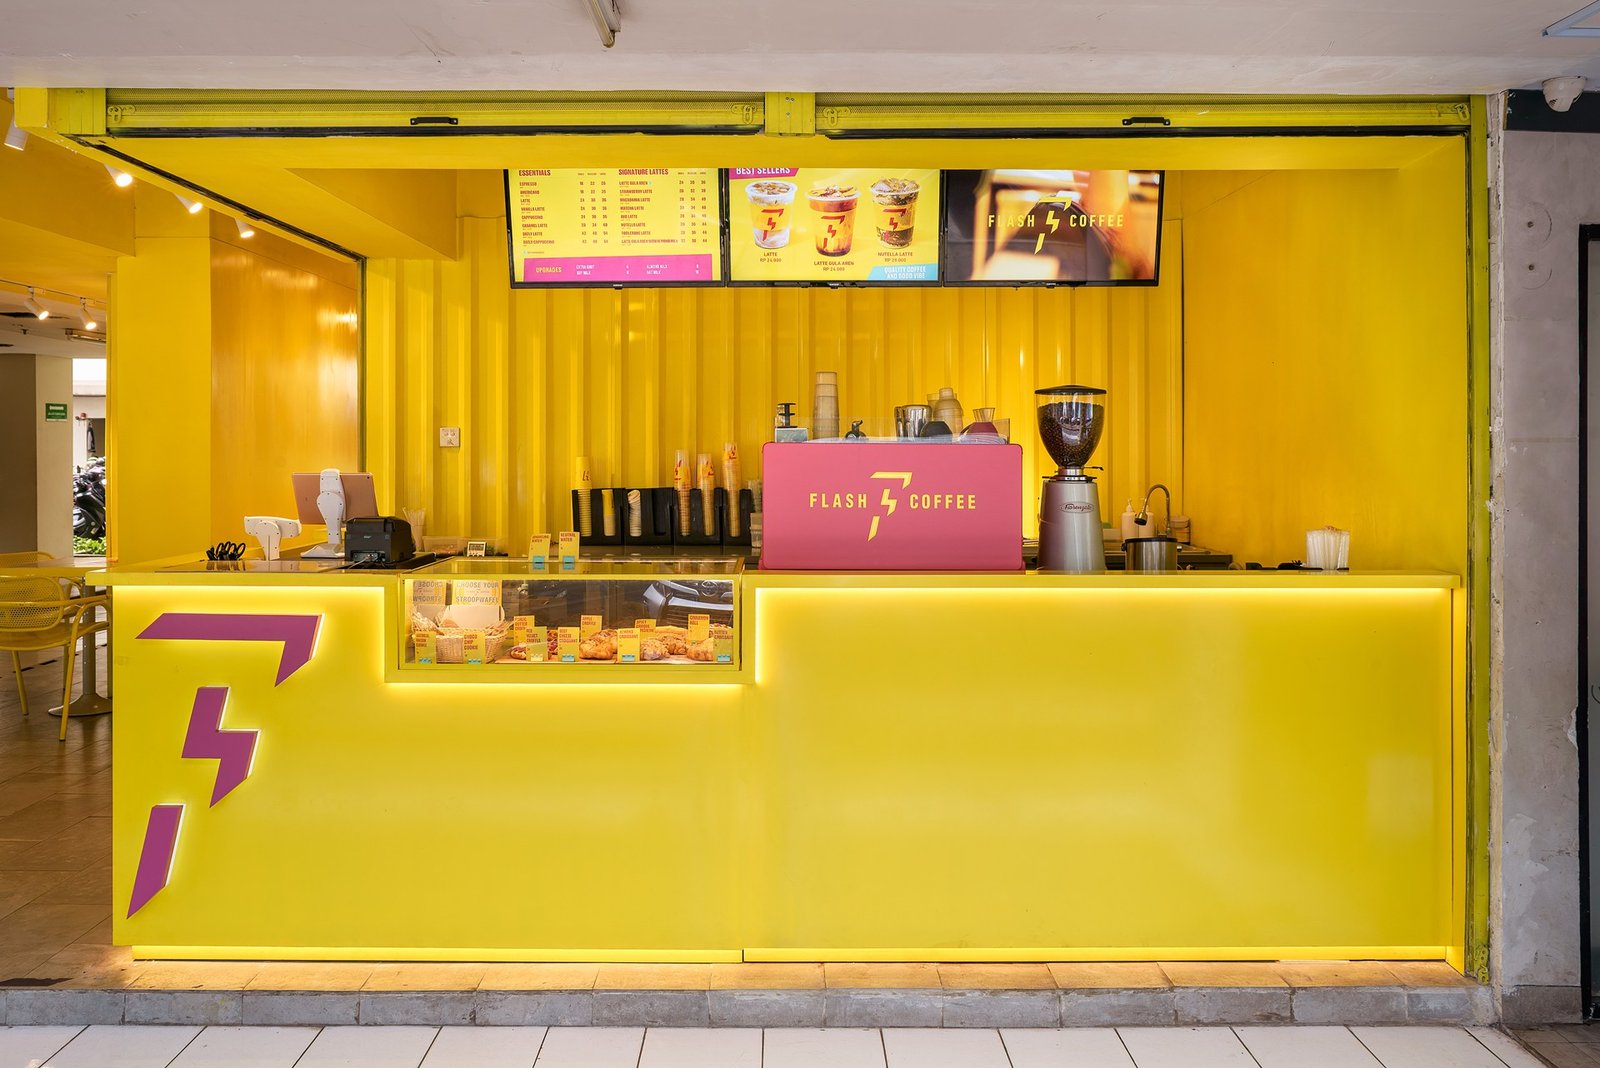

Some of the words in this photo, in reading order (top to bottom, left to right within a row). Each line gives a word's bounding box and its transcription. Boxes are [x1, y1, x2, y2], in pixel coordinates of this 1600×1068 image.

[518, 169, 552, 177] ESSENTIALS
[618, 168, 648, 176] SIGNATURE
[649, 168, 669, 176] LATTES
[736, 167, 755, 175] BEST
[988, 215, 1035, 227] FLASH
[1069, 215, 1124, 227] COFFEE
[809, 493, 867, 508] FLASH
[909, 493, 977, 509] COFFEE
